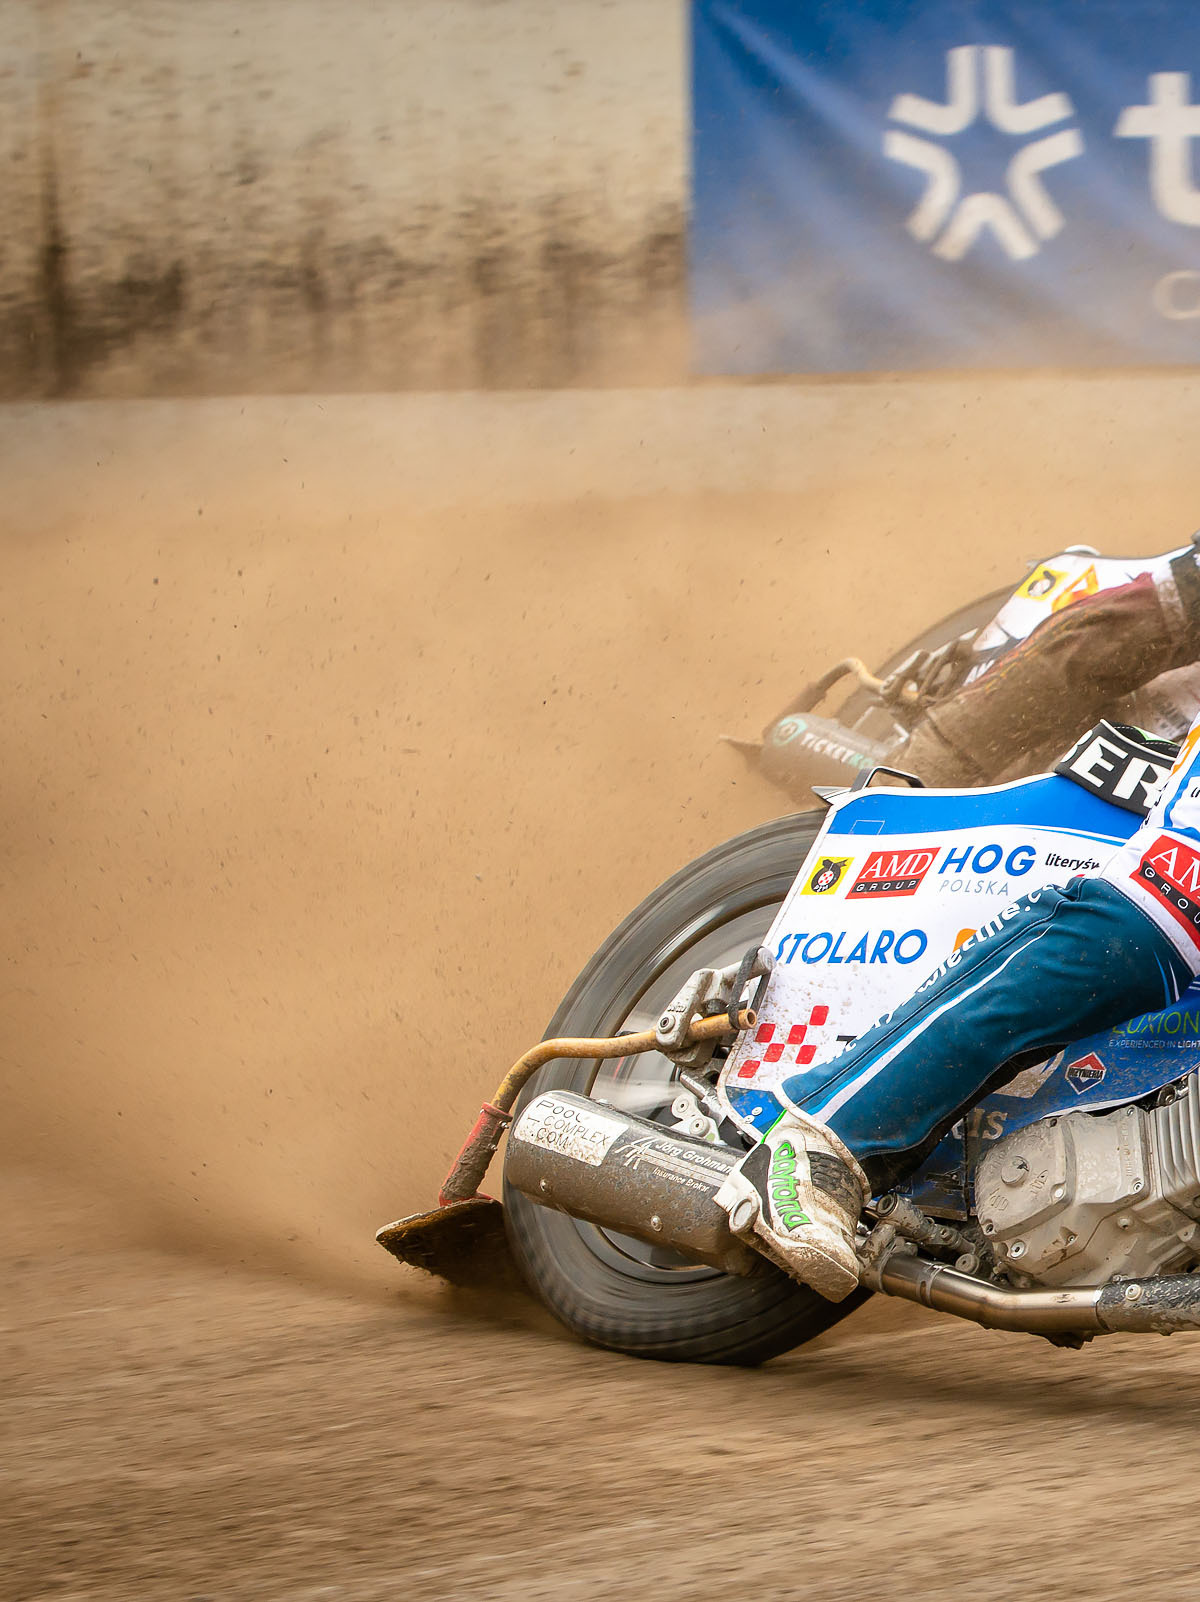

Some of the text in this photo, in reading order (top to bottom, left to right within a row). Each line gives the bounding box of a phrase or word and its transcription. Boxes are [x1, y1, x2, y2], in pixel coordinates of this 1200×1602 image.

[859, 853, 934, 879] AMD
[938, 844, 1037, 877] HOG
[856, 878, 1010, 897] GROUP POLSKA
[776, 929, 928, 965] STOLARO
